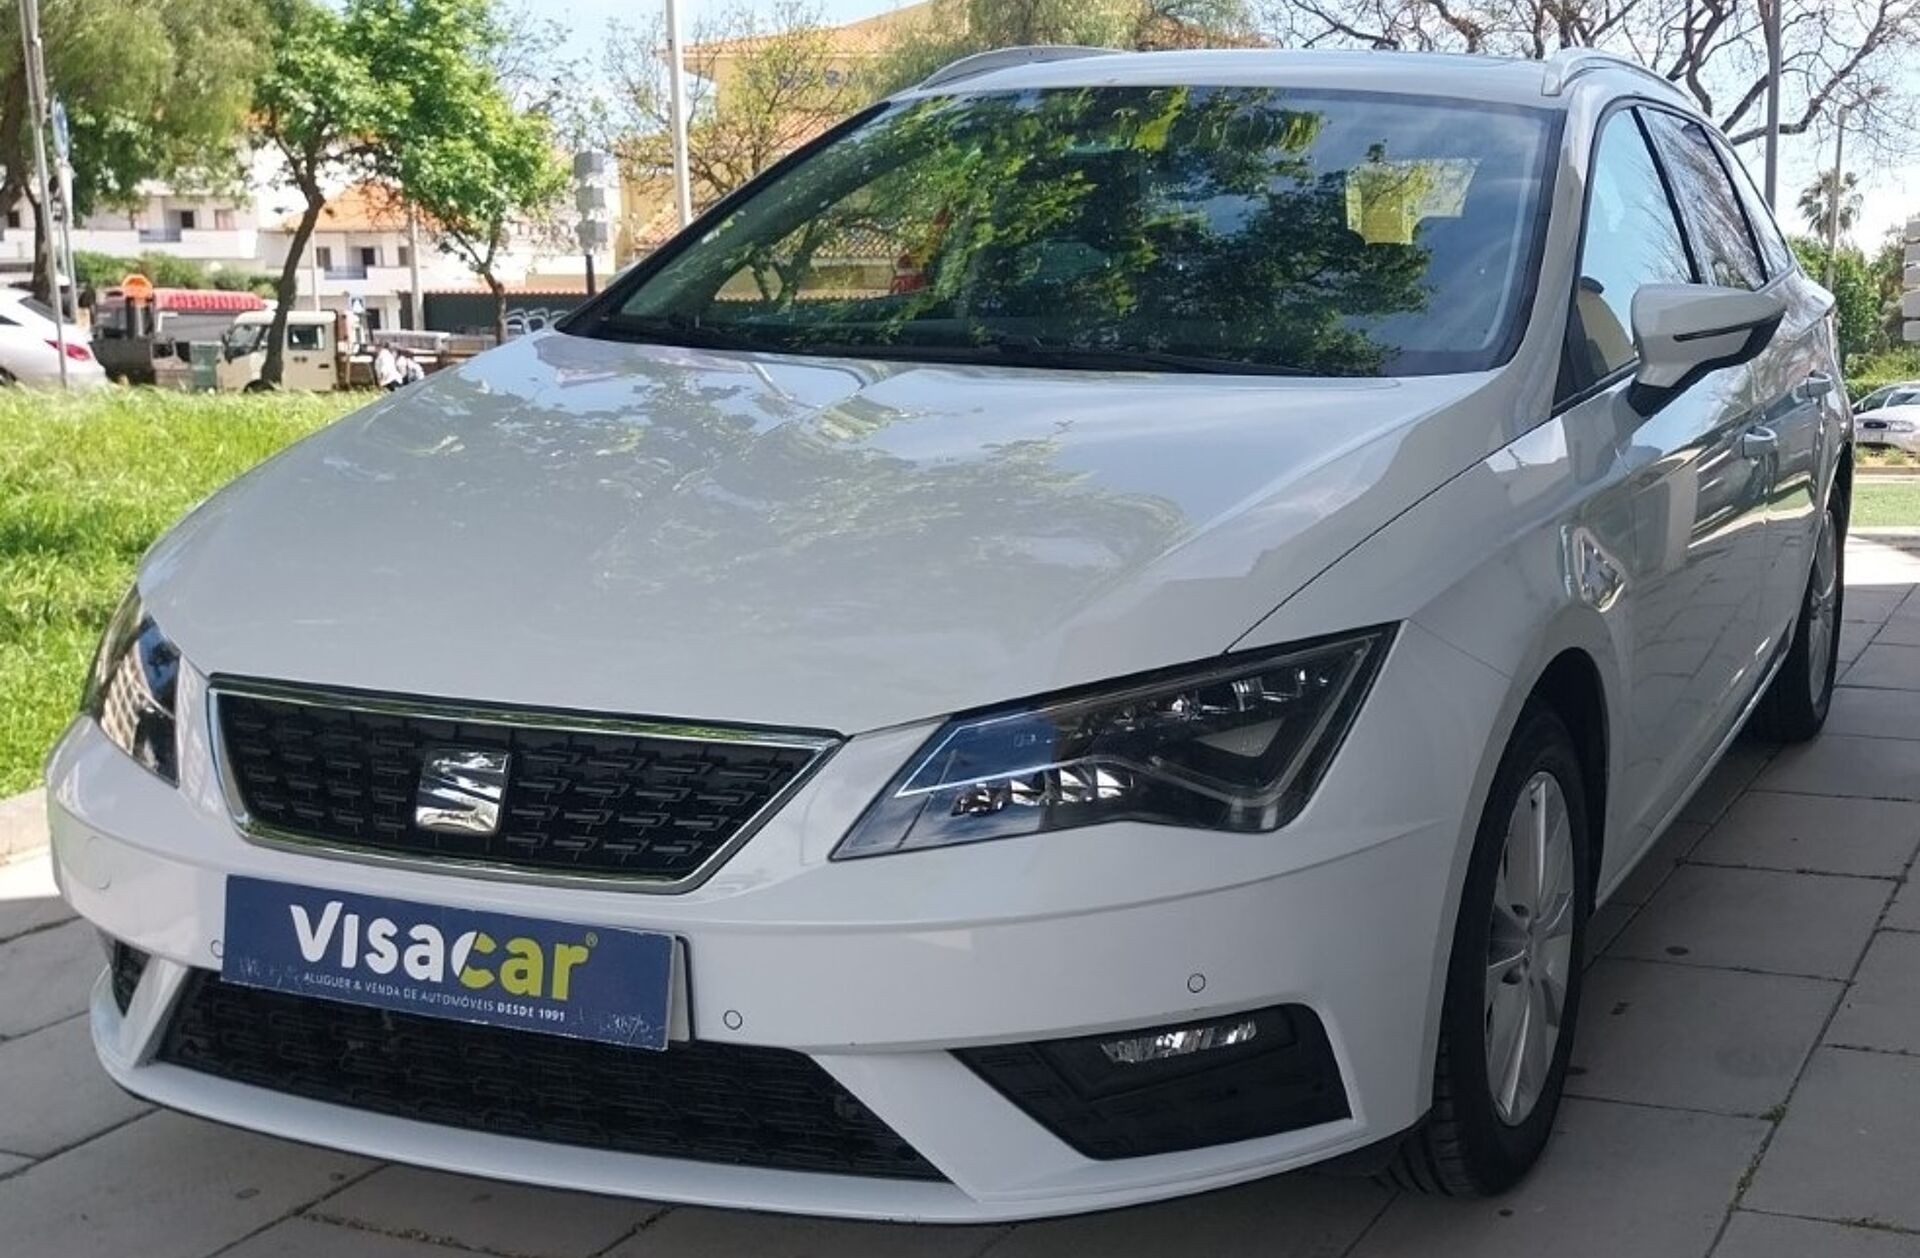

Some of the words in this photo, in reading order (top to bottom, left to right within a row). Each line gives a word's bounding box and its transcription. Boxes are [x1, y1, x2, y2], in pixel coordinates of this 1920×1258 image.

[303, 972, 351, 989] ALUGUER
[353, 980, 362, 990] &
[366, 981, 400, 996] VENDA
[403, 988, 418, 1000] DE
[421, 991, 494, 1012] AUTOMÓVEIS
[497, 1002, 534, 1018] DESDE
[539, 1007, 565, 1022] 1991
